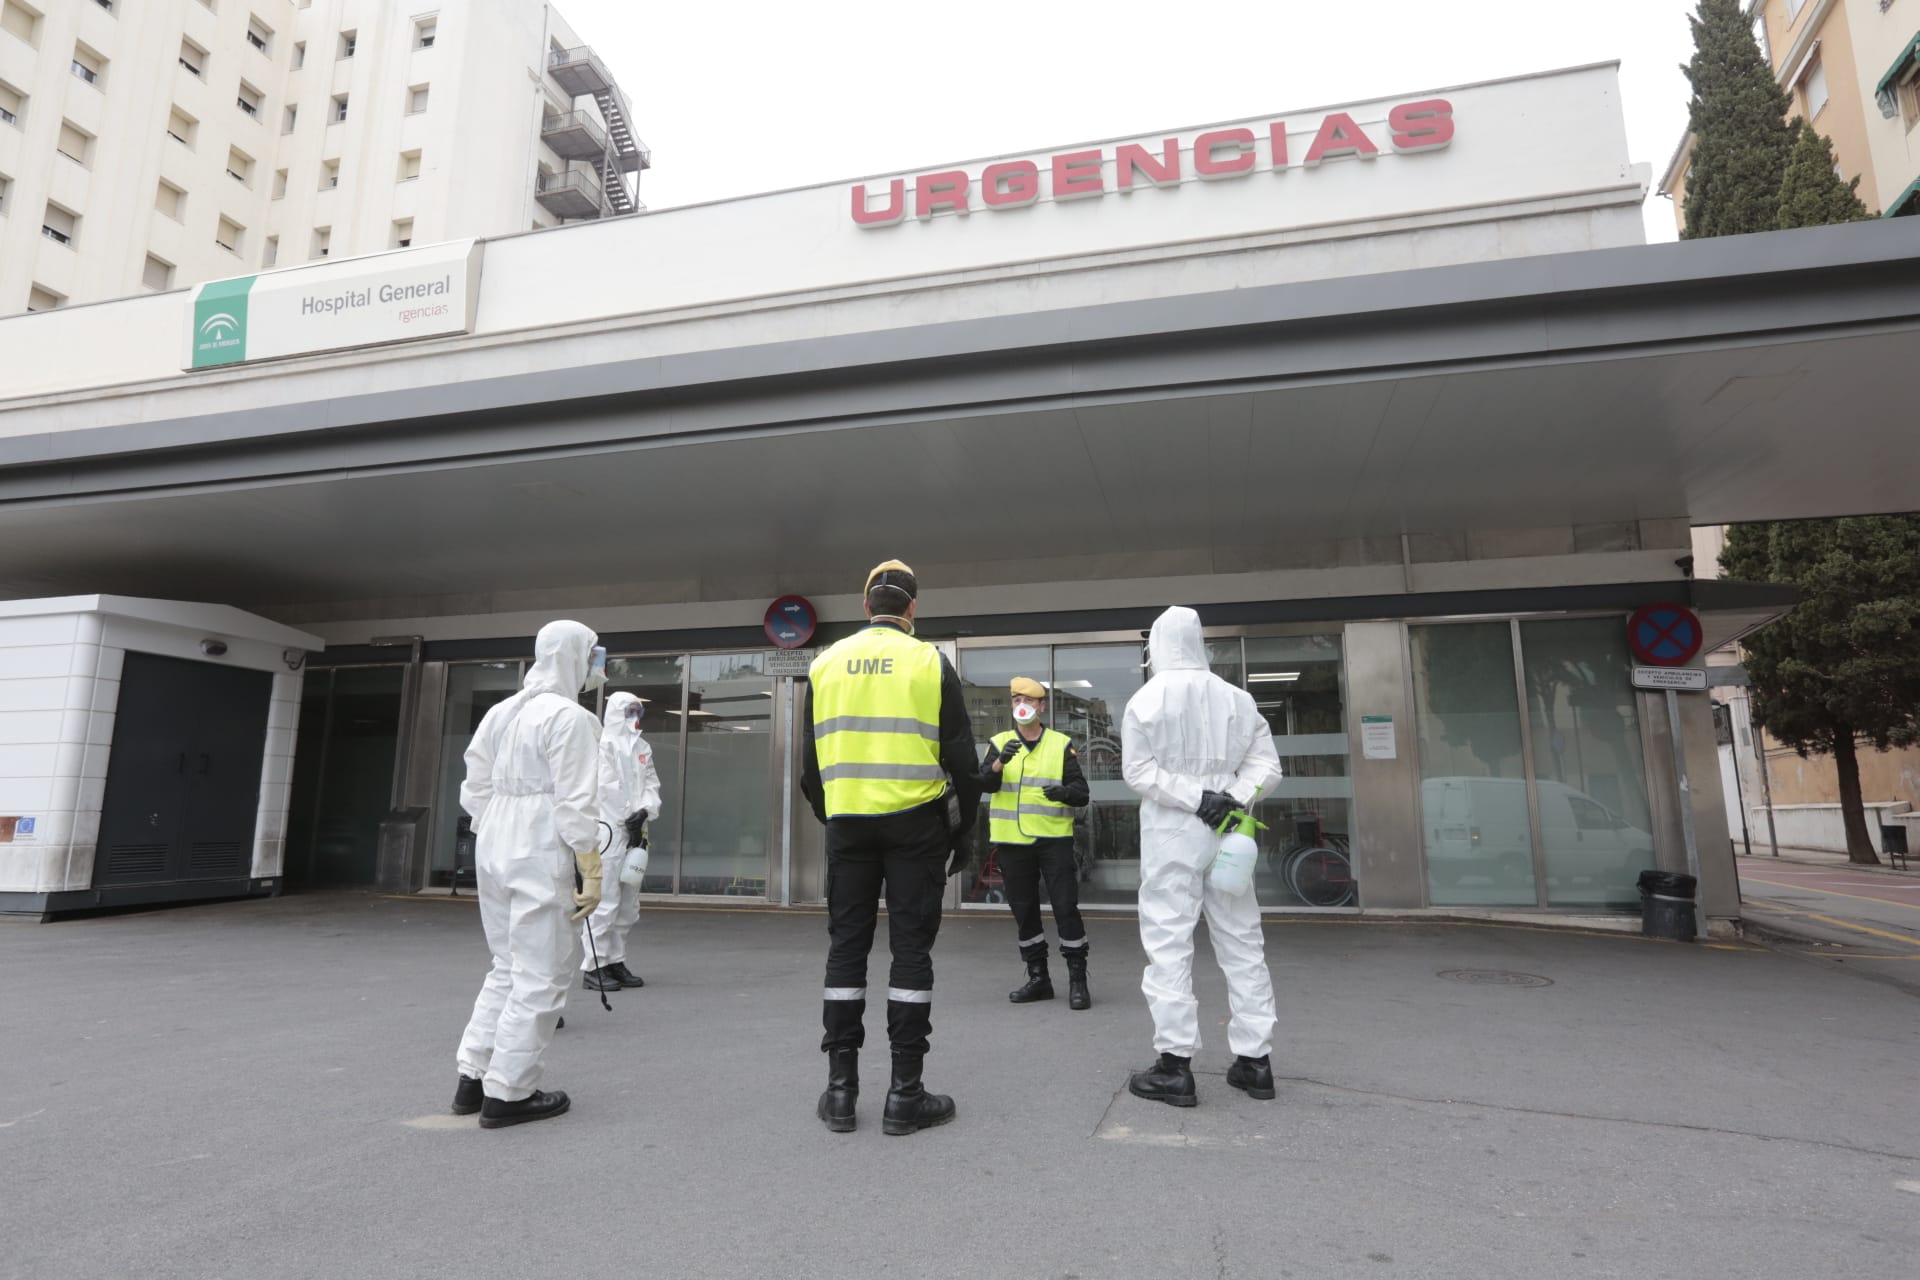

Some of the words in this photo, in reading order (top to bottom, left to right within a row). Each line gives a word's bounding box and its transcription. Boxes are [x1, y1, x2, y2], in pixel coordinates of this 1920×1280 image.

[850, 98, 1455, 228] URGENCIAS
[302, 287, 371, 315] Hospital
[378, 274, 450, 303] General
[847, 658, 893, 675] UME
